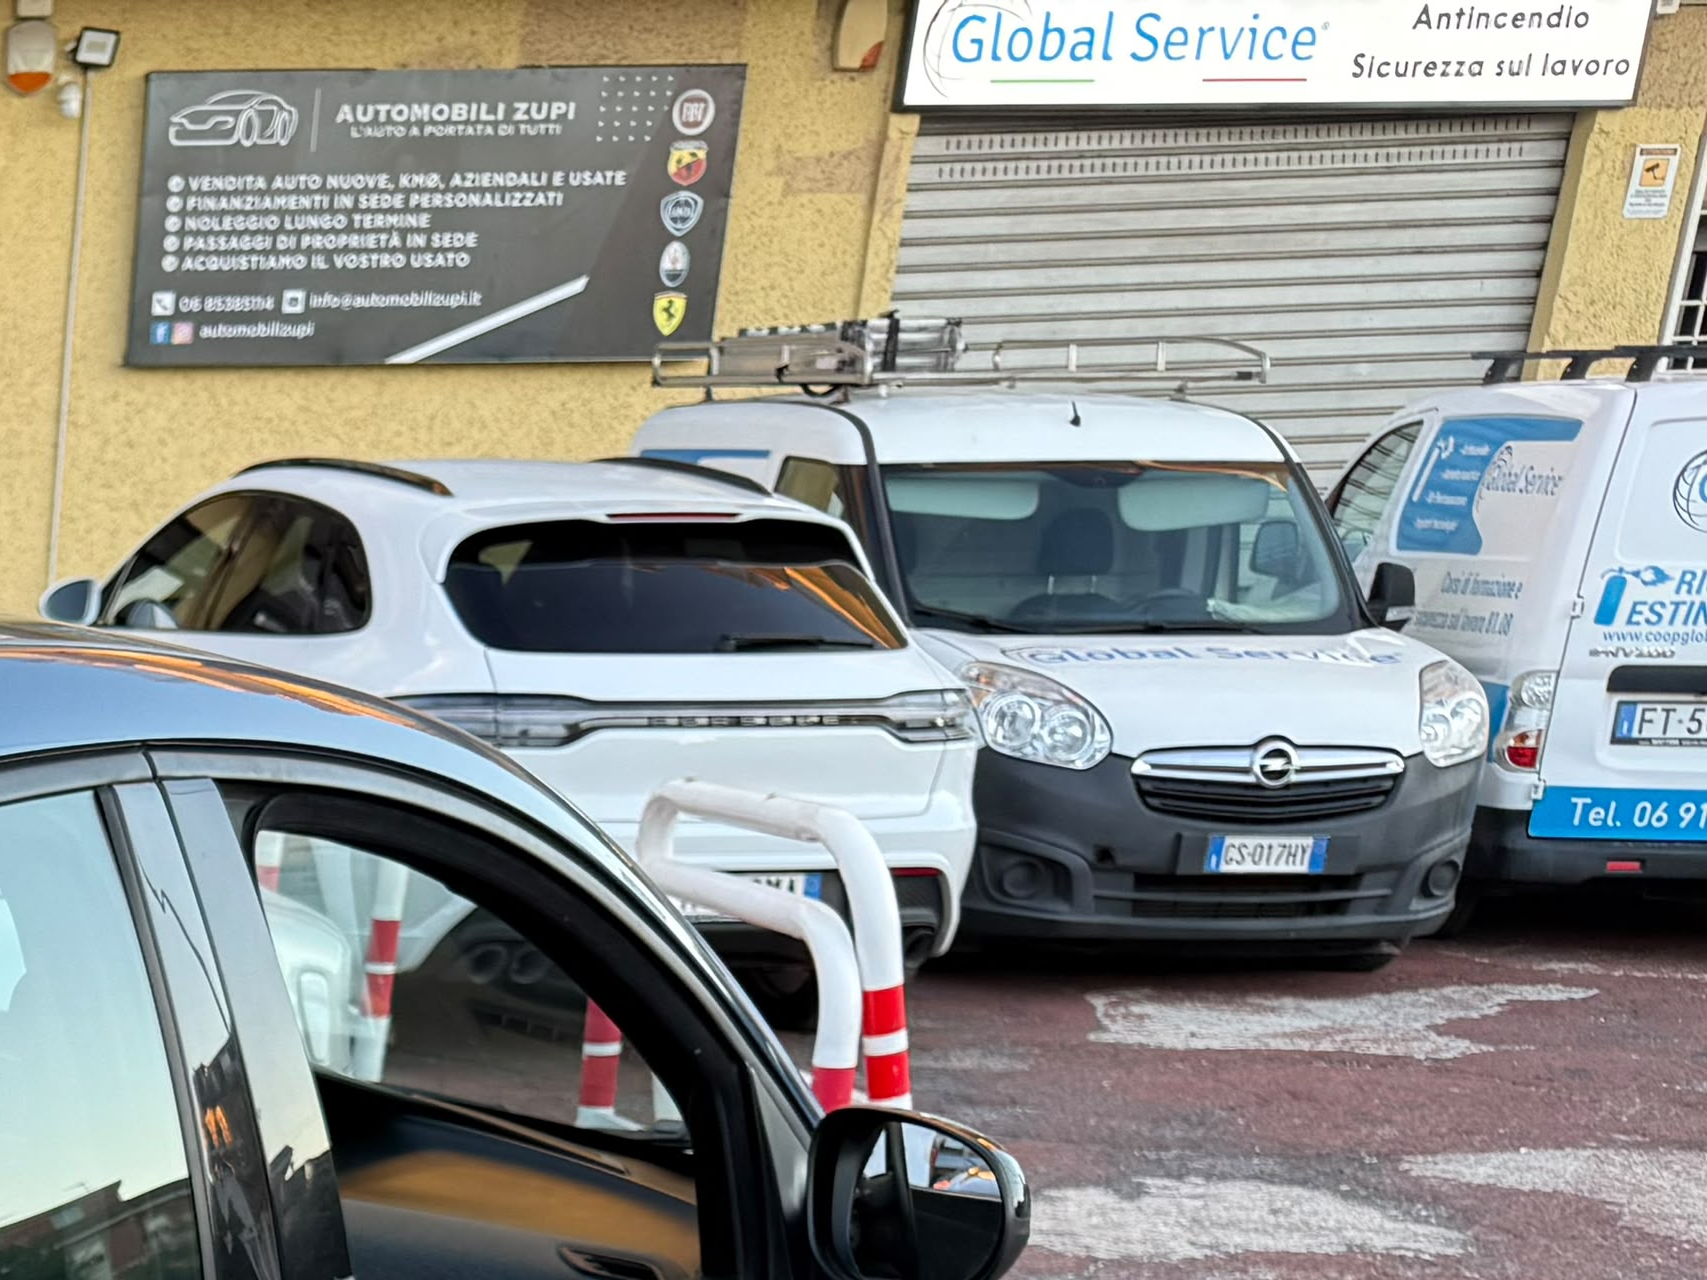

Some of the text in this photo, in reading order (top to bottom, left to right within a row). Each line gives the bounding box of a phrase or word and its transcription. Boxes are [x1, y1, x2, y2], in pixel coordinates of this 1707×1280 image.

[1412, 3, 1590, 30] Antincendio
[952, 11, 1115, 63] Global
[1352, 53, 1631, 79] Sicurezza sul lavoro
[335, 101, 577, 124] AUTOMOBILI ZUPI
[518, 123, 563, 136] TUTTI
[188, 175, 267, 191] VENDITA
[271, 174, 322, 190] AUTO
[450, 172, 549, 188] AZIENDALI
[553, 171, 566, 186] E
[570, 170, 627, 187] USATE
[186, 191, 563, 211] FINANZIAMENTI IN SEDE PERSONALIZZATI
[185, 213, 431, 232] NOLEGGIO LUNGO TERMINE
[184, 231, 479, 252] PASSAGGI DI PROPRIETÀ IN SEDE
[182, 251, 471, 271] ACQUISTIAMO IL VOSTRO USATO
[1675, 570, 1707, 595] RI
[1571, 797, 1622, 827] Tel.
[1633, 800, 1669, 828] 06
